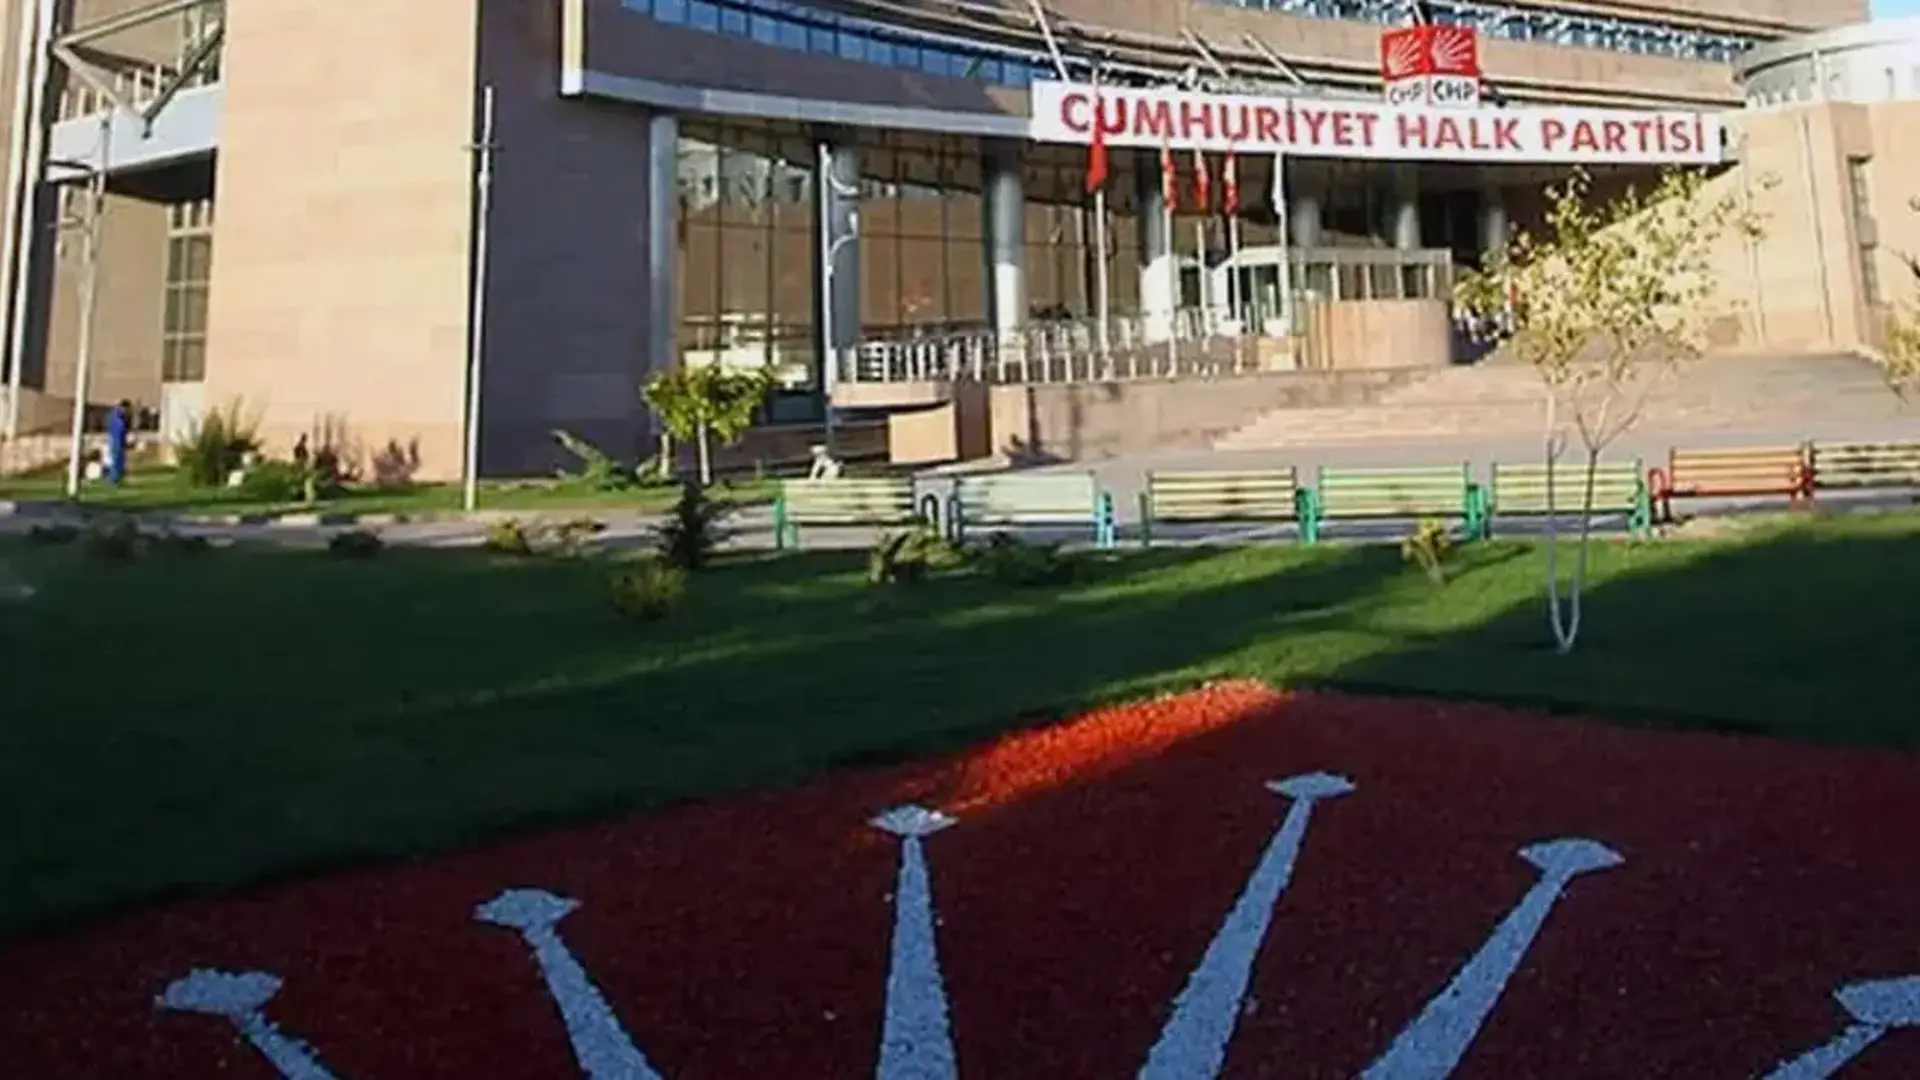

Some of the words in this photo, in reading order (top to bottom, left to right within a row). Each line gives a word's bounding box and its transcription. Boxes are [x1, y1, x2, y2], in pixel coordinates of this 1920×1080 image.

[1432, 79, 1476, 101] CHP
[1060, 92, 1379, 147] CUMHURİYET
[1397, 114, 1523, 151] HALK
